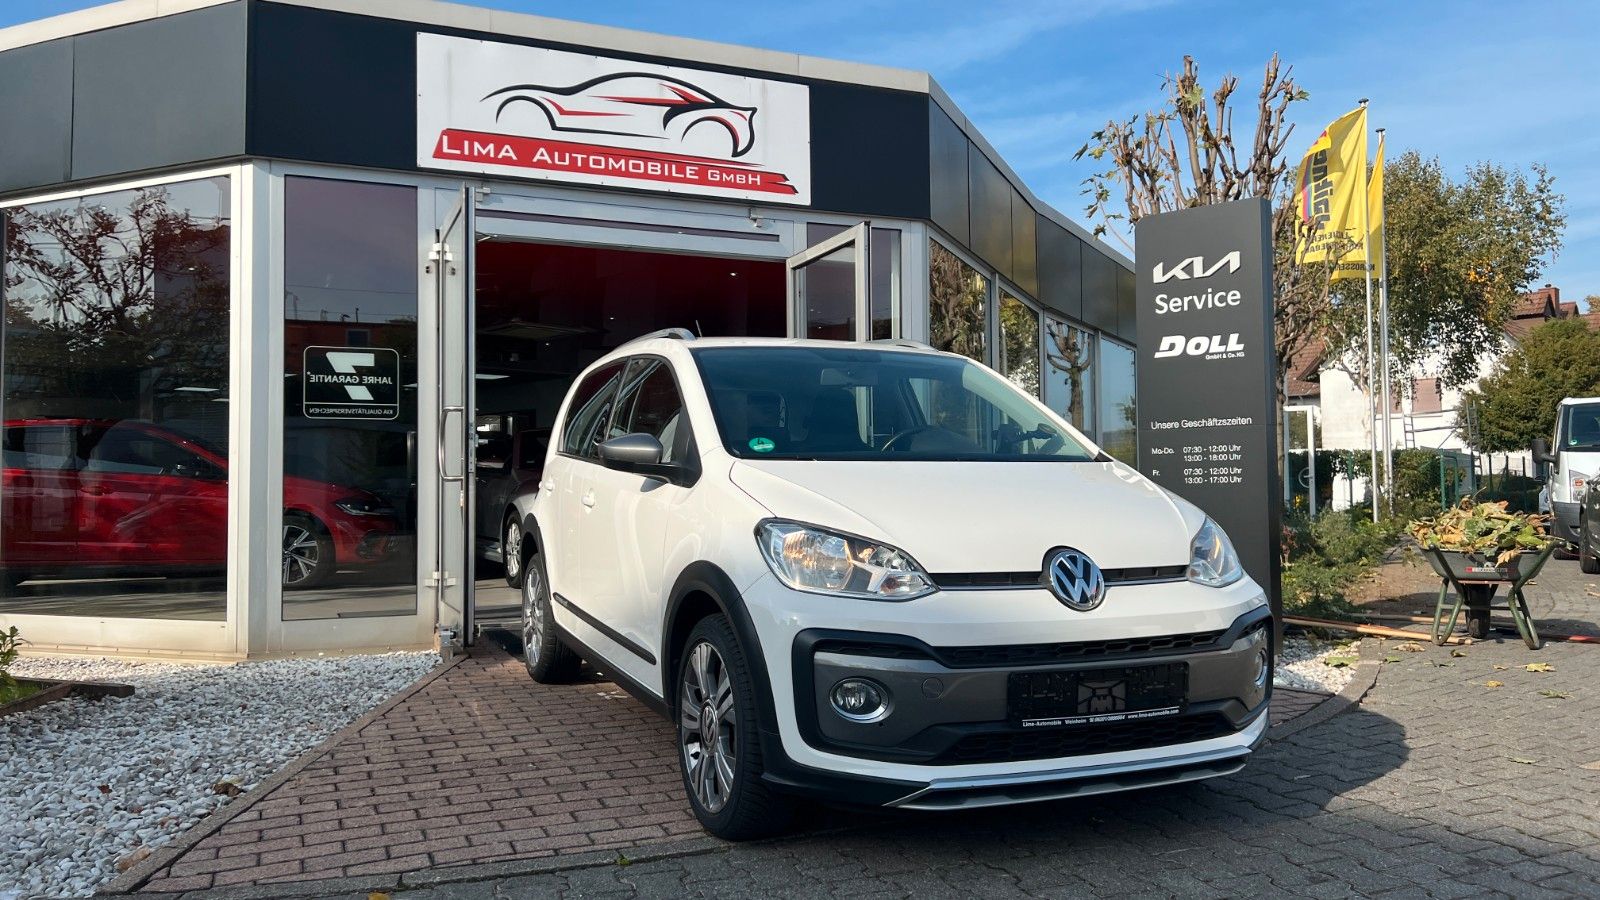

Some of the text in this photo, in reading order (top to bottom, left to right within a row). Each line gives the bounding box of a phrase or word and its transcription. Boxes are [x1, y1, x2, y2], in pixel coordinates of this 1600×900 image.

[1153, 250, 1241, 284] KIA
[1155, 287, 1241, 314] Service
[1154, 333, 1244, 359] DOLL
[1151, 421, 1179, 430] Unsere
[1228, 444, 1241, 452] Uhr
[1210, 467, 1228, 475] 12:00
